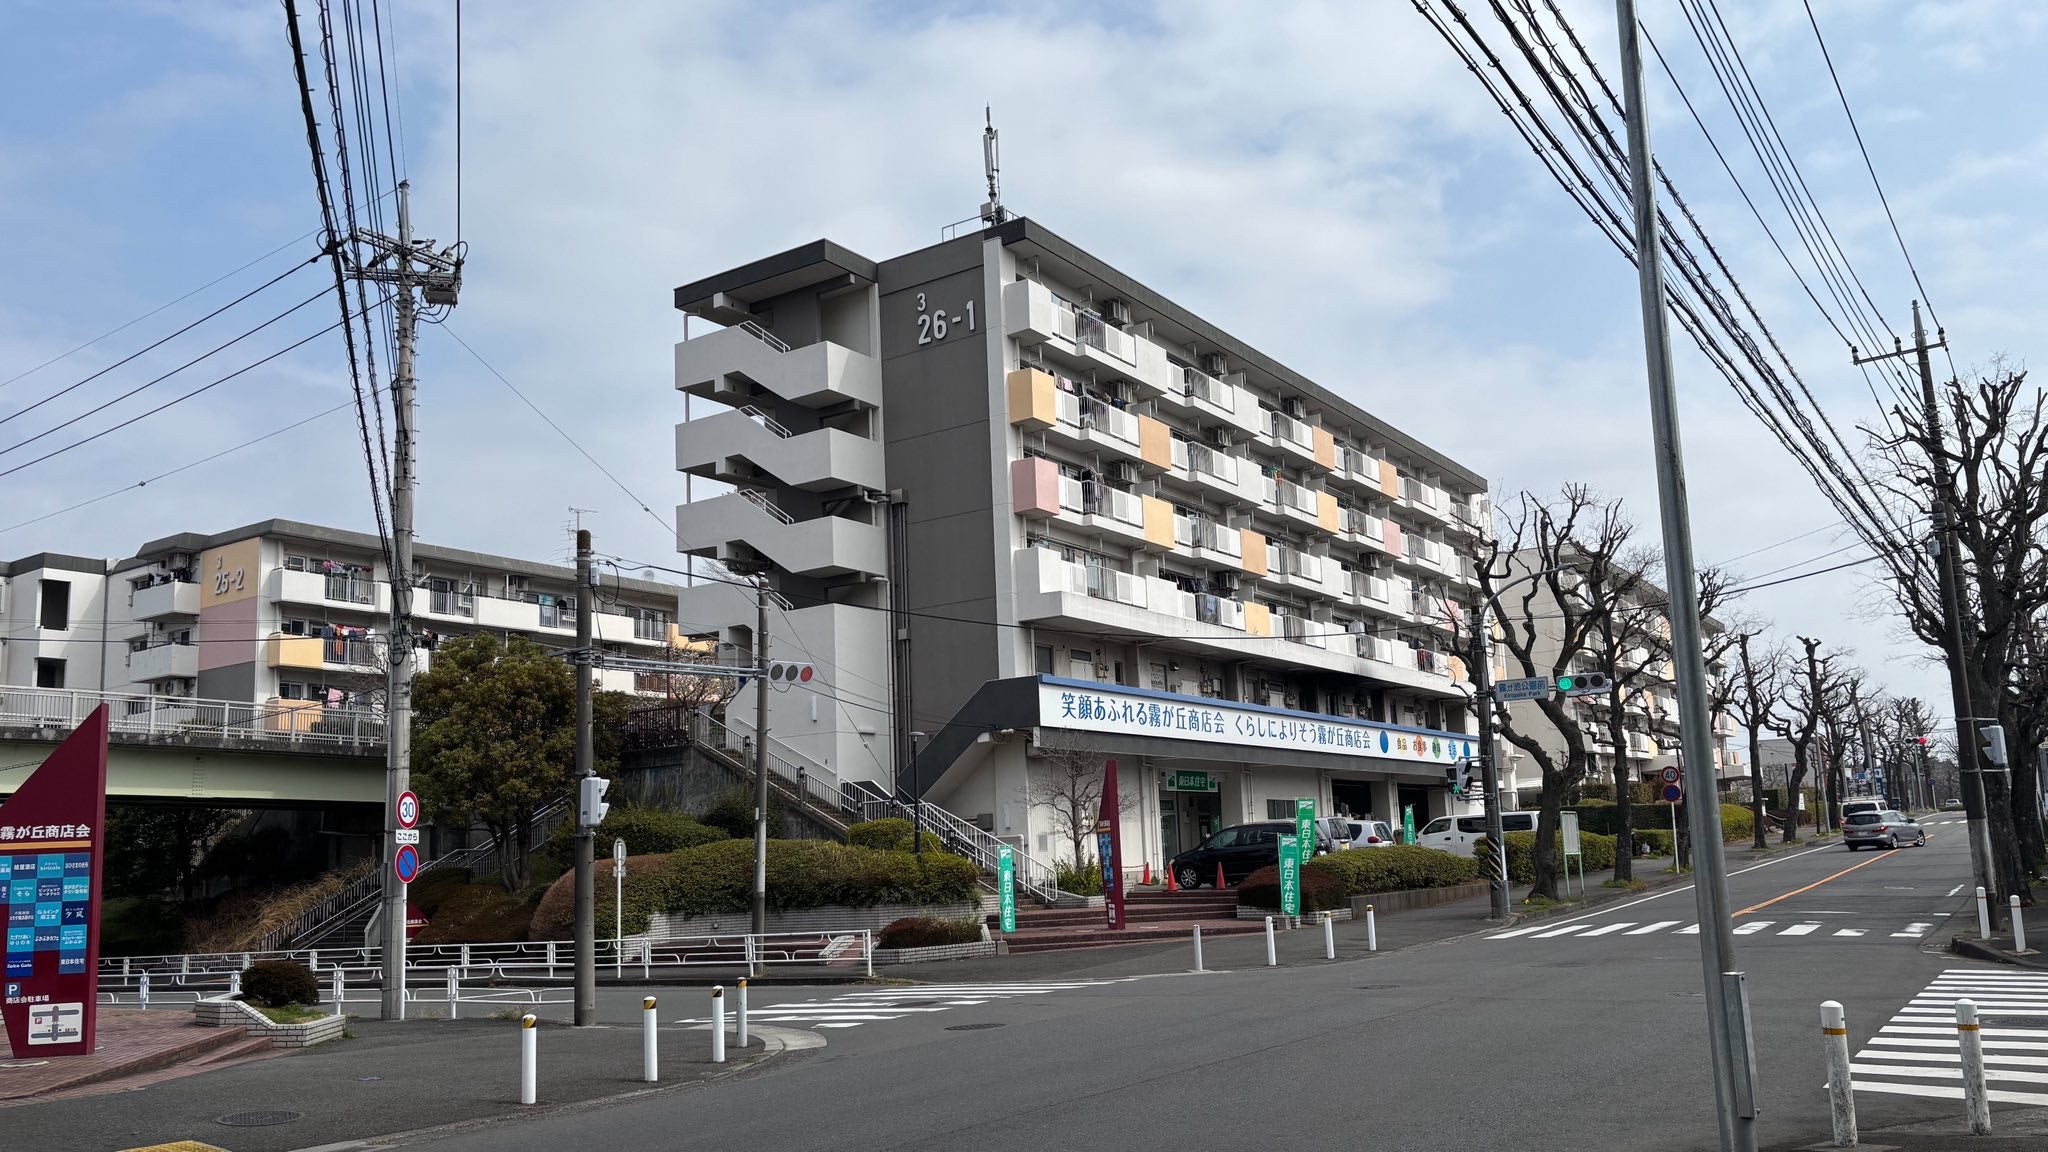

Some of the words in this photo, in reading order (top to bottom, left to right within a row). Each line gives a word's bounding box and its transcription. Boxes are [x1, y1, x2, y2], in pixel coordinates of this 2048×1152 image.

[917, 293, 926, 311] 3
[918, 300, 975, 345] 26-1
[216, 555, 223, 570] 3
[215, 568, 245, 596] 25-2
[1061, 692, 1225, 734] 笑顔あふれる霧が丘商店会
[1235, 714, 1371, 749] くらしによりそう霧が丘商店会
[1179, 775, 1207, 787] 東日本住宅
[1665, 770, 1676, 779] 40
[402, 802, 414, 818] 30
[0, 824, 91, 840] 霧が丘商店会
[398, 832, 418, 841] ここから
[1284, 858, 1296, 914] 東日本住宅
[1004, 870, 1012, 929] 東日本住宅
[8, 984, 18, 995] P
